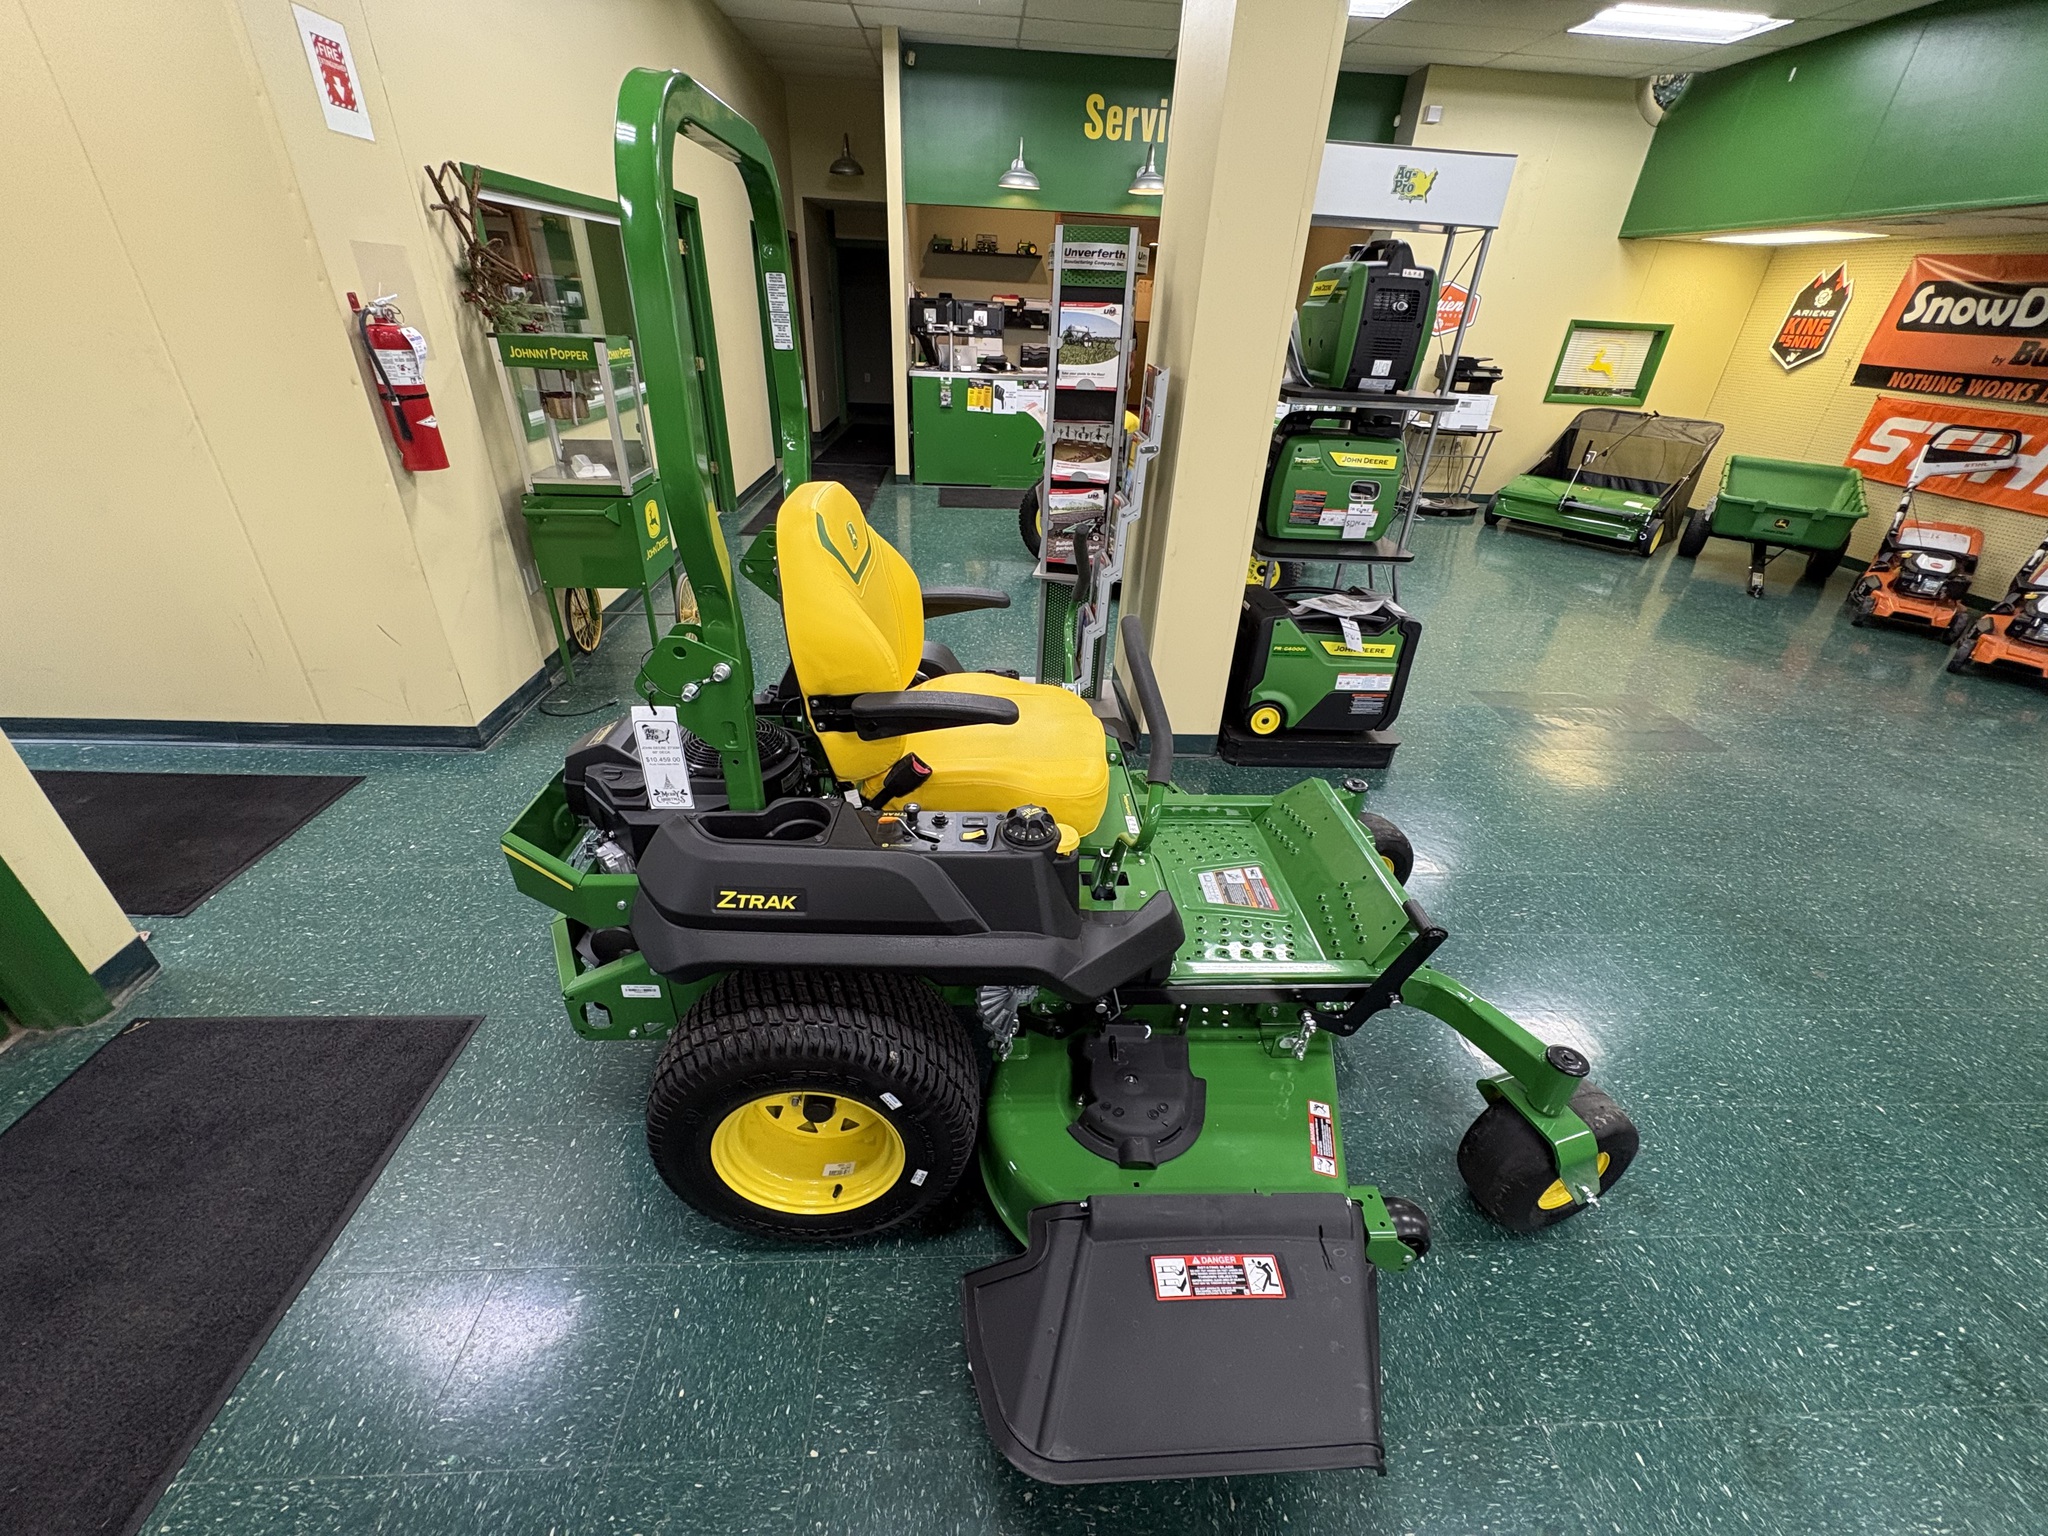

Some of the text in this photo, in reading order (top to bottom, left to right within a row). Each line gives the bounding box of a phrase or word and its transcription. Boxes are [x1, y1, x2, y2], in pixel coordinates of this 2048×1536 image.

[317, 42, 341, 62] FIRE
[1084, 93, 1168, 143] Servi
[1392, 180, 1414, 193] Pro
[1064, 248, 1126, 259] Unverferth
[1783, 318, 1833, 336] KING
[1783, 335, 1825, 349] SNOW
[510, 346, 589, 360] JOHNNY POPPER
[1992, 355, 2005, 366] by
[1887, 372, 1964, 394] NOTHING
[1966, 379, 2040, 402] WORKS
[647, 536, 669, 561] JOHN DEERE
[717, 891, 797, 910] ZTRAK
[1201, 1256, 1236, 1264] DANGER
